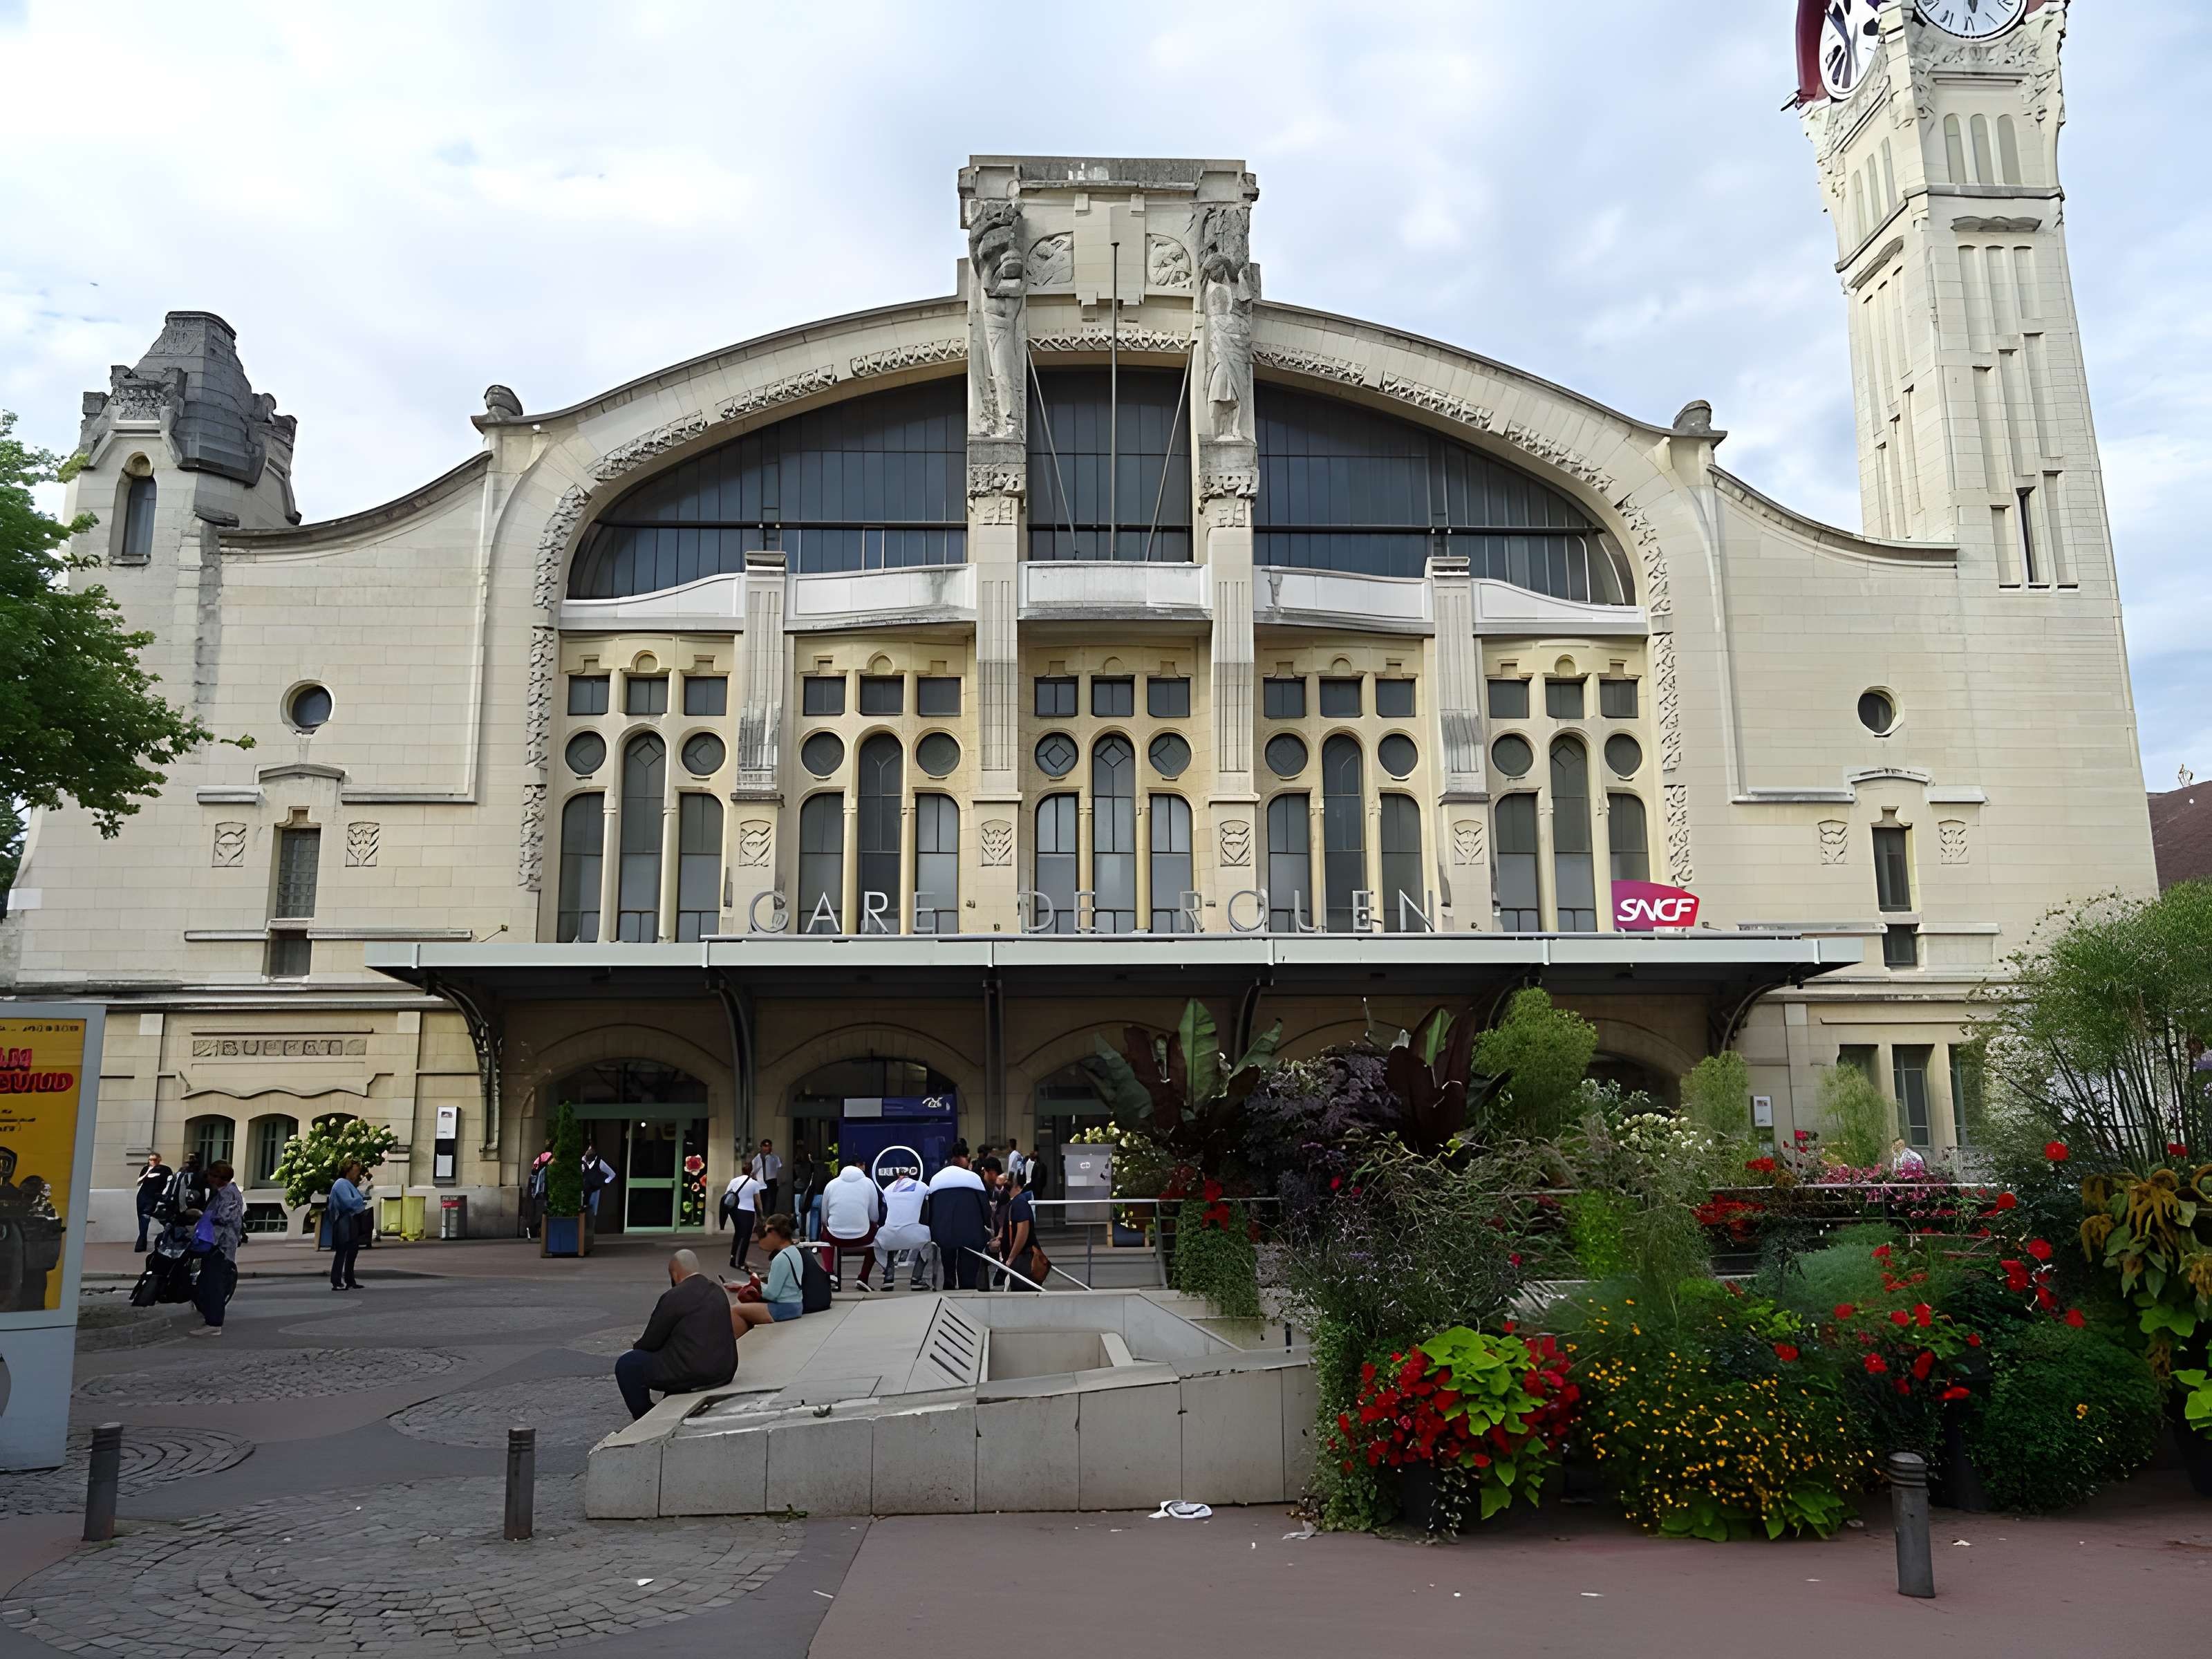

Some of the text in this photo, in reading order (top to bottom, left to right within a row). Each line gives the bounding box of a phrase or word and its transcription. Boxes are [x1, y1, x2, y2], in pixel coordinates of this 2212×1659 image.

[749, 889, 1435, 932] GARE DE ROUEN
[1617, 898, 1695, 921] SNCF
